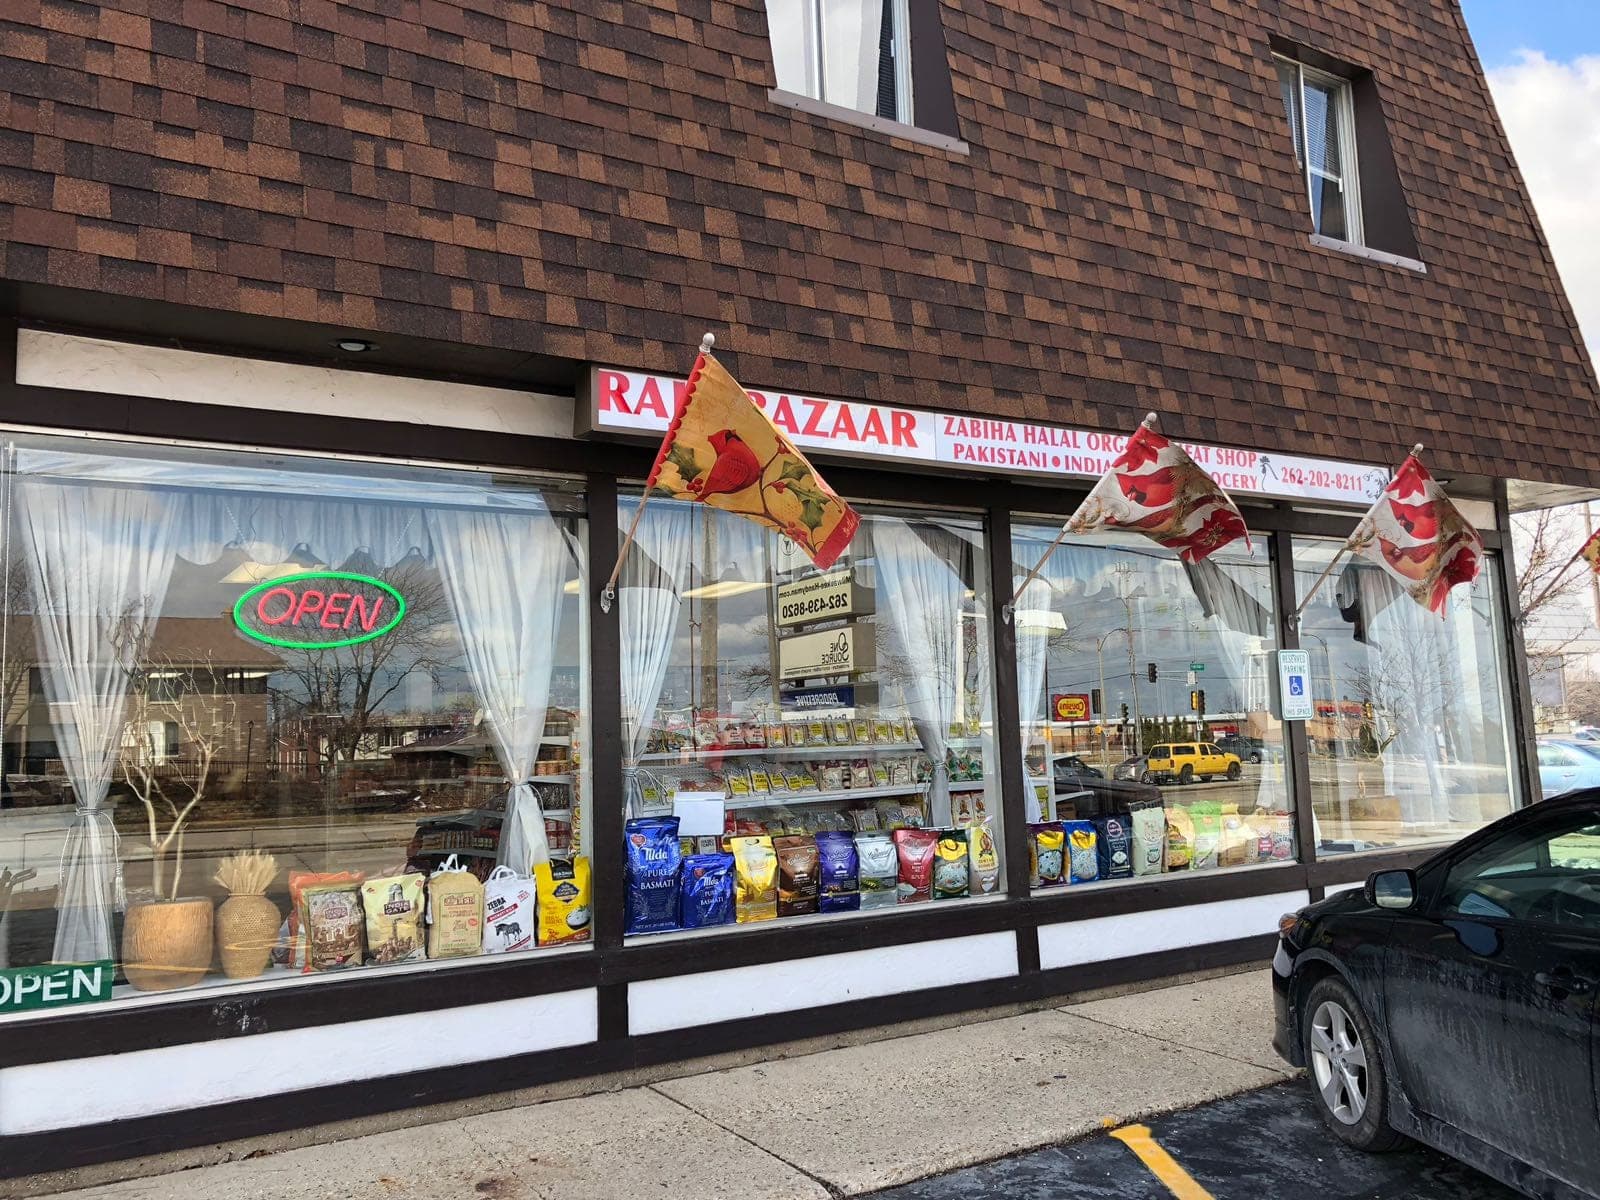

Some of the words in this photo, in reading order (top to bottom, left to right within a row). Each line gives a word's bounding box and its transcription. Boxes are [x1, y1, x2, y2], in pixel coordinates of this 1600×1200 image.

[943, 416, 1017, 442] ZABIHA
[1023, 425, 1081, 449] HALAL
[1086, 431, 1128, 454] ORG
[1178, 444, 1209, 464] EAT
[1216, 449, 1257, 468] SHOP
[953, 443, 1047, 468] PAKISTANI
[1065, 455, 1112, 475] INDIA
[1213, 471, 1258, 490] OCERY
[1281, 466, 1363, 491] 262-202-8211
[257, 587, 385, 632] OPEN
[641, 879, 674, 890] BASMATI
